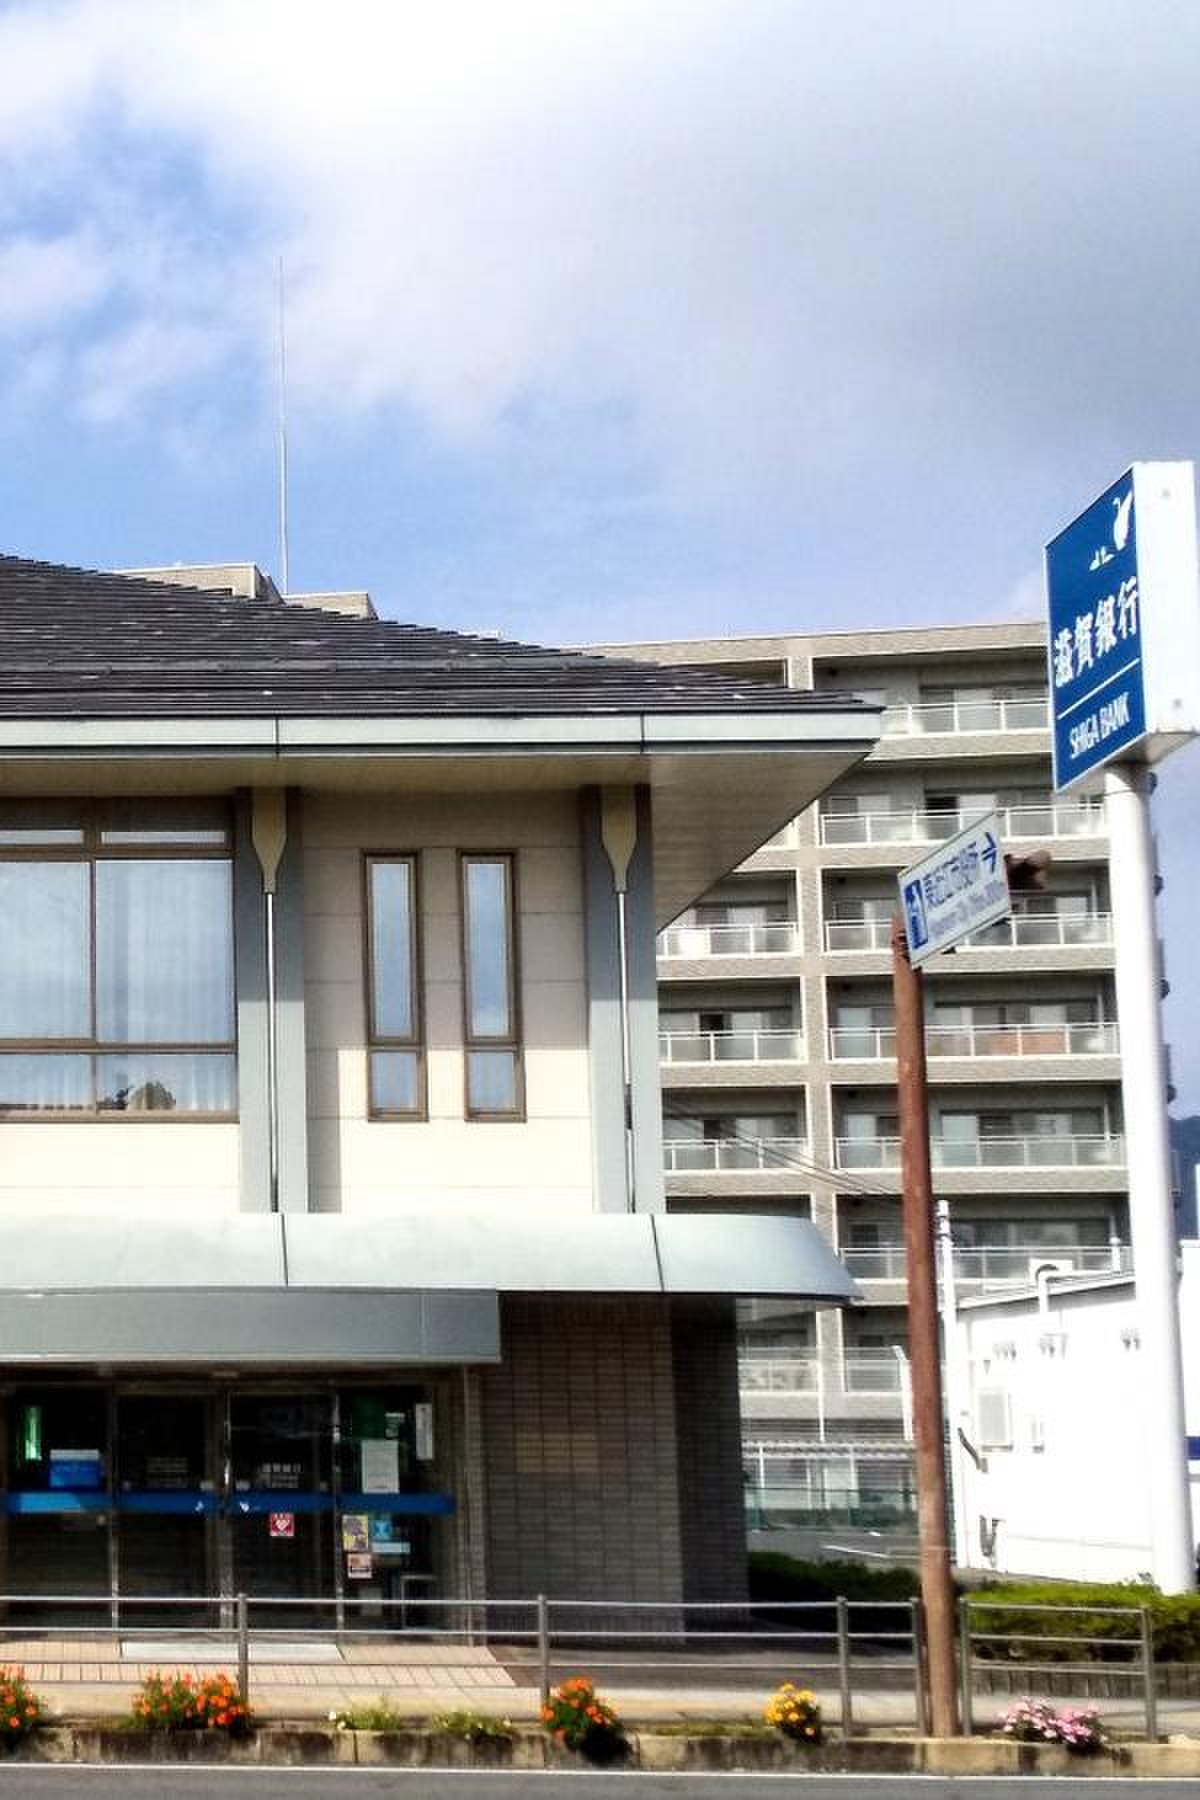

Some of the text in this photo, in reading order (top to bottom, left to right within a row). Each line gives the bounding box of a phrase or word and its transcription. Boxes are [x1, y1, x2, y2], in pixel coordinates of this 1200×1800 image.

[1054, 577, 1138, 687] 滋賀銀行
[1069, 691, 1131, 760] SHIGA BANK
